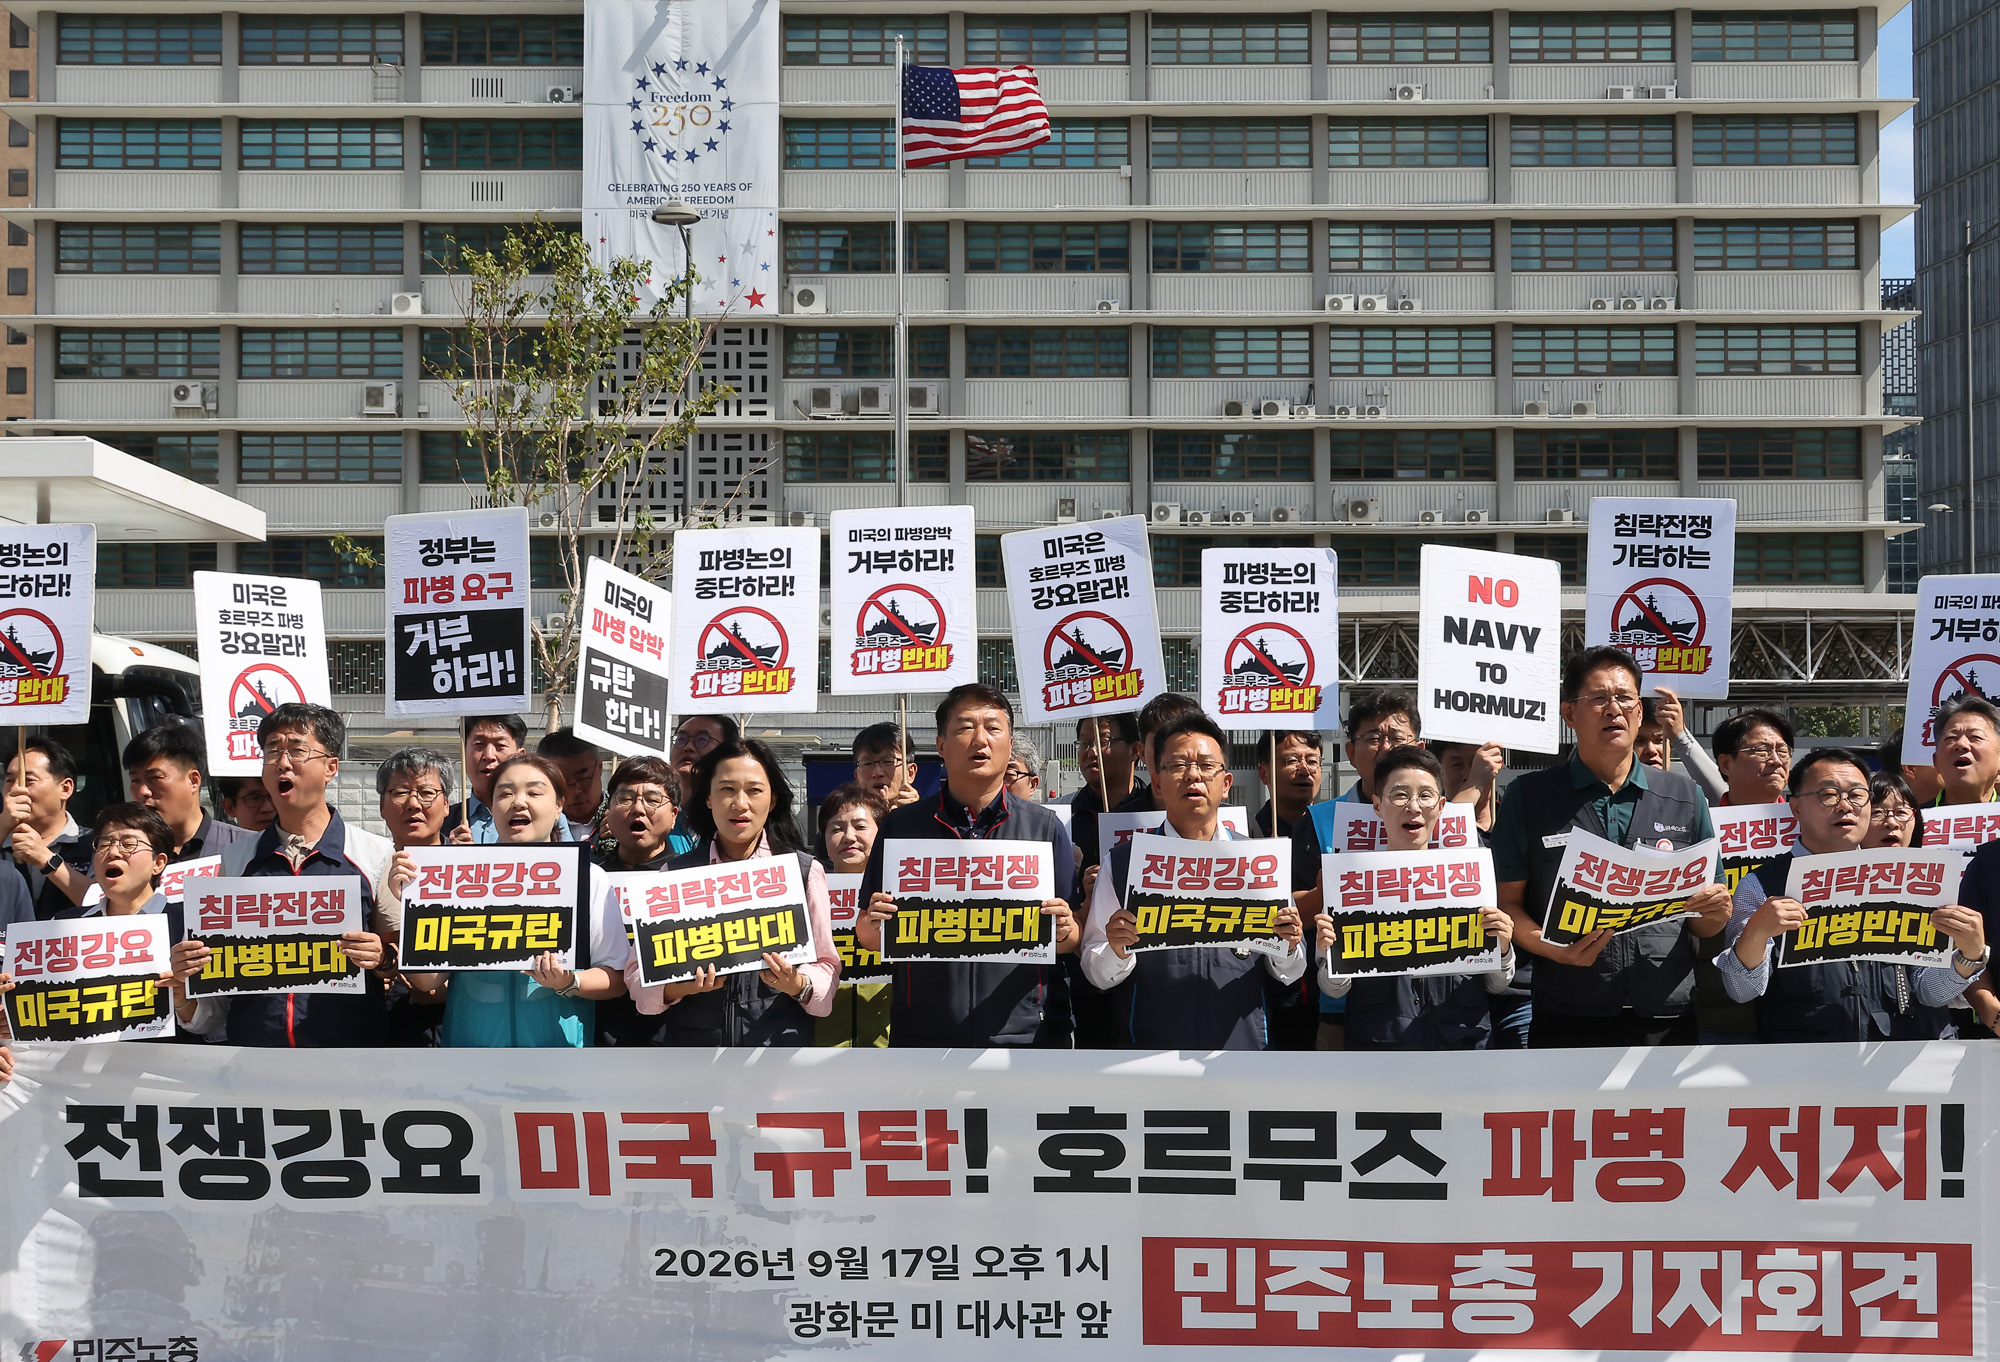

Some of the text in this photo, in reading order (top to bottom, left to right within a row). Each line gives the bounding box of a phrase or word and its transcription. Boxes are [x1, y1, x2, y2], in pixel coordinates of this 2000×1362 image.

[650, 91, 712, 103] Freedom
[651, 104, 712, 136] 250
[608, 182, 753, 192] CELEBRATING 250 YEARS OF
[684, 196, 734, 205] FREEDOM
[630, 209, 648, 219] 미국
[711, 209, 729, 219] 기념
[848, 526, 953, 543] 미국의 파병압박
[1613, 513, 1713, 539] 침략전쟁
[419, 536, 496, 567] 정부는
[698, 547, 792, 572] 파병논의
[848, 548, 955, 574] 거부하라!
[1043, 531, 1106, 559] 미국은
[1612, 544, 1711, 570] 가담하는
[1028, 554, 1126, 583] 호르무즈 파병
[1223, 562, 1316, 585] 파병논의
[233, 583, 288, 607] 미국은
[403, 572, 514, 604] 파병 요구
[604, 580, 653, 623] 미국의
[694, 575, 795, 599] 중단하라!
[1031, 575, 1130, 610] 강요말라!
[1219, 591, 1320, 614] 중단하라!
[1468, 575, 1519, 608] NO
[1934, 595, 1978, 610] 미국의
[218, 609, 304, 630] 호르무즈 파병
[592, 608, 665, 660] 파병 압박
[1443, 615, 1541, 654] NAVY
[220, 631, 307, 658] 강요말라!
[403, 615, 473, 657] 거부
[855, 636, 901, 648] 호르무즈
[1609, 632, 1658, 645] 호르무즈
[431, 649, 516, 693] 하라!
[695, 658, 742, 671] 호르무즈
[856, 645, 949, 674] 파병반대
[1044, 664, 1090, 681] 호르무즈
[1475, 661, 1508, 685] TO
[1623, 646, 1707, 672] 병반대
[589, 656, 636, 699] 규탄
[695, 667, 793, 697] 파병반대
[1045, 671, 1140, 707] 파병반대
[1222, 675, 1268, 687] 호르무즈
[1223, 687, 1318, 713] 파병반대
[1433, 688, 1546, 722] HORMUZ!
[229, 719, 259, 731] 호르무
[605, 698, 662, 740] 한다!
[1719, 816, 1801, 854] 전쟁강
[419, 861, 562, 900] 전쟁강요
[897, 855, 1039, 892] 침략전쟁
[1141, 853, 1279, 891] 전쟁강요
[1339, 861, 1482, 908] 침략전쟁
[1572, 851, 1708, 897] 전쟁강요
[1801, 861, 1946, 904] 침략전쟁
[645, 865, 788, 918] 침략전쟁
[199, 889, 346, 931] 침략전쟁
[896, 906, 1040, 944] 파병반대
[1136, 904, 1278, 935] 미국규탄
[414, 912, 563, 952] 미국규탄
[650, 909, 797, 968] 파병반대
[1341, 913, 1485, 960] 파병반대
[1793, 910, 1938, 951] 파병반대
[14, 929, 154, 977] 전쟁강요
[200, 940, 347, 980] 파병반대
[15, 979, 159, 1027] 미국규탄
[64, 1103, 1966, 1203] 전쟁강요 미국 규탄! 호르무즈 파병 저지!
[654, 1243, 1111, 1281] 2026년 9월 17일 오후 1시
[1174, 1246, 1940, 1340] 민주노총 기자회견
[788, 1299, 1112, 1340] 광화문 미 대사관 앞
